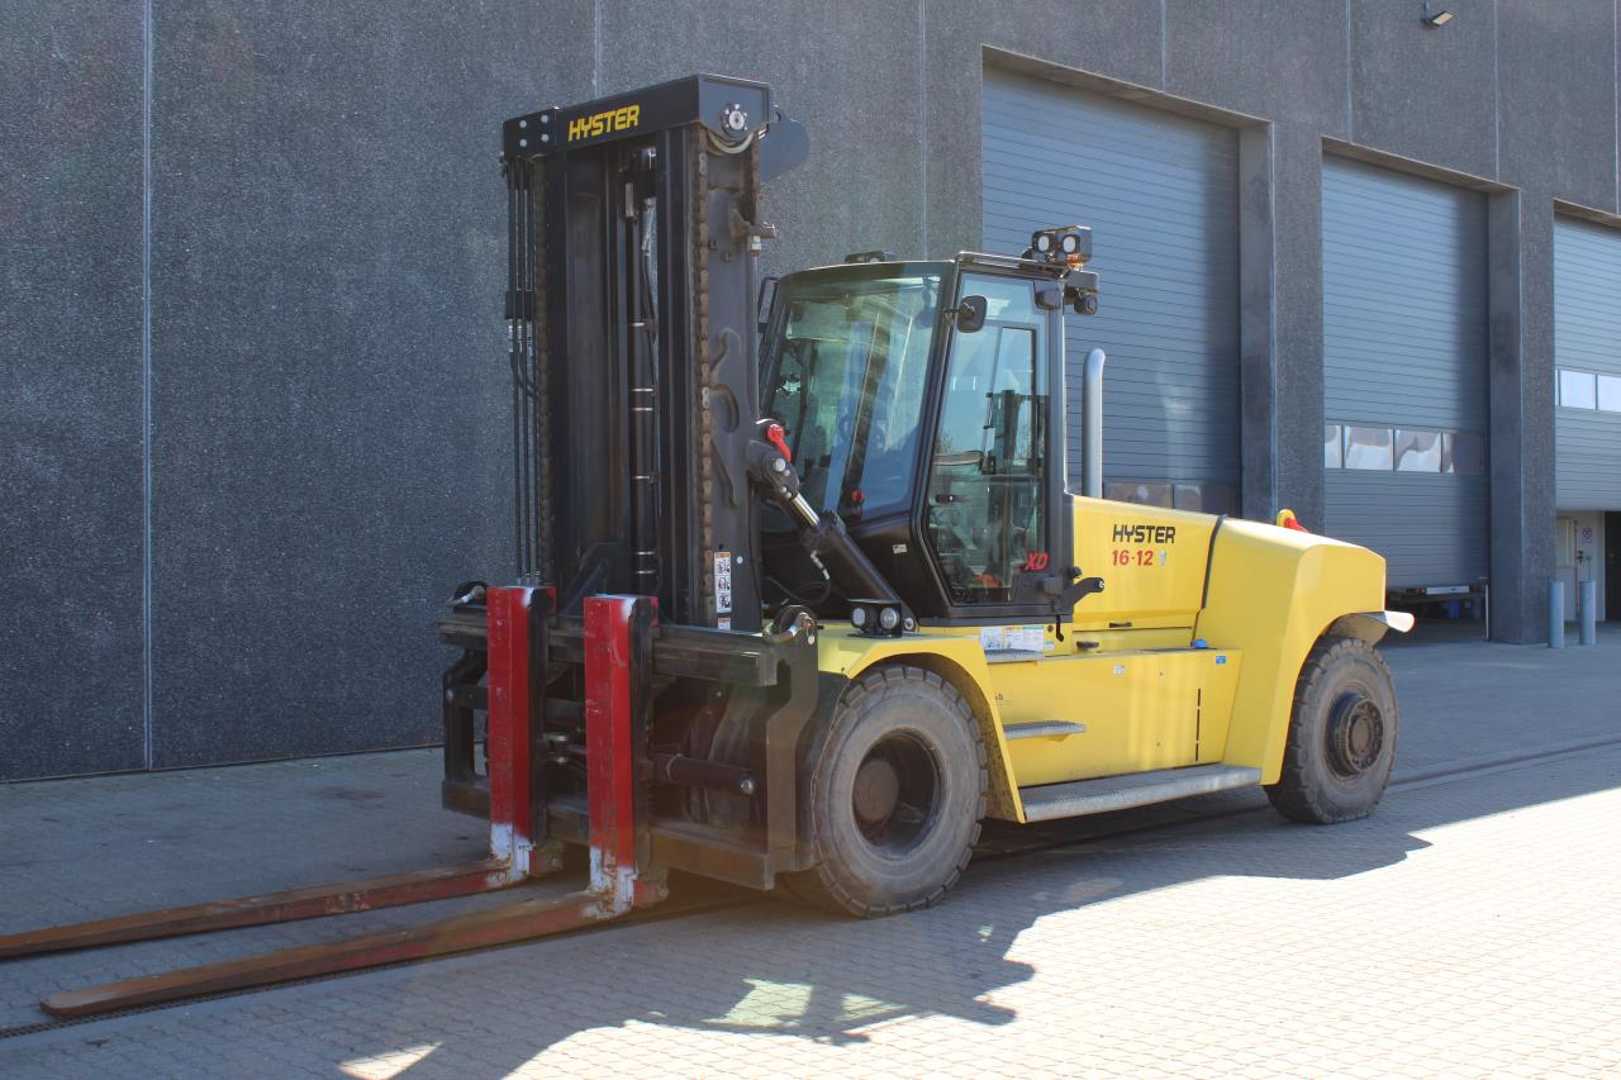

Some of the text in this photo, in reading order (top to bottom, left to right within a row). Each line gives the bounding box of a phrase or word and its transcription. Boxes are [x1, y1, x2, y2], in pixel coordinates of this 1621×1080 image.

[568, 104, 640, 142] HYSTER
[1112, 524, 1176, 544] HYSTER
[1112, 550, 1154, 566] 16-12
